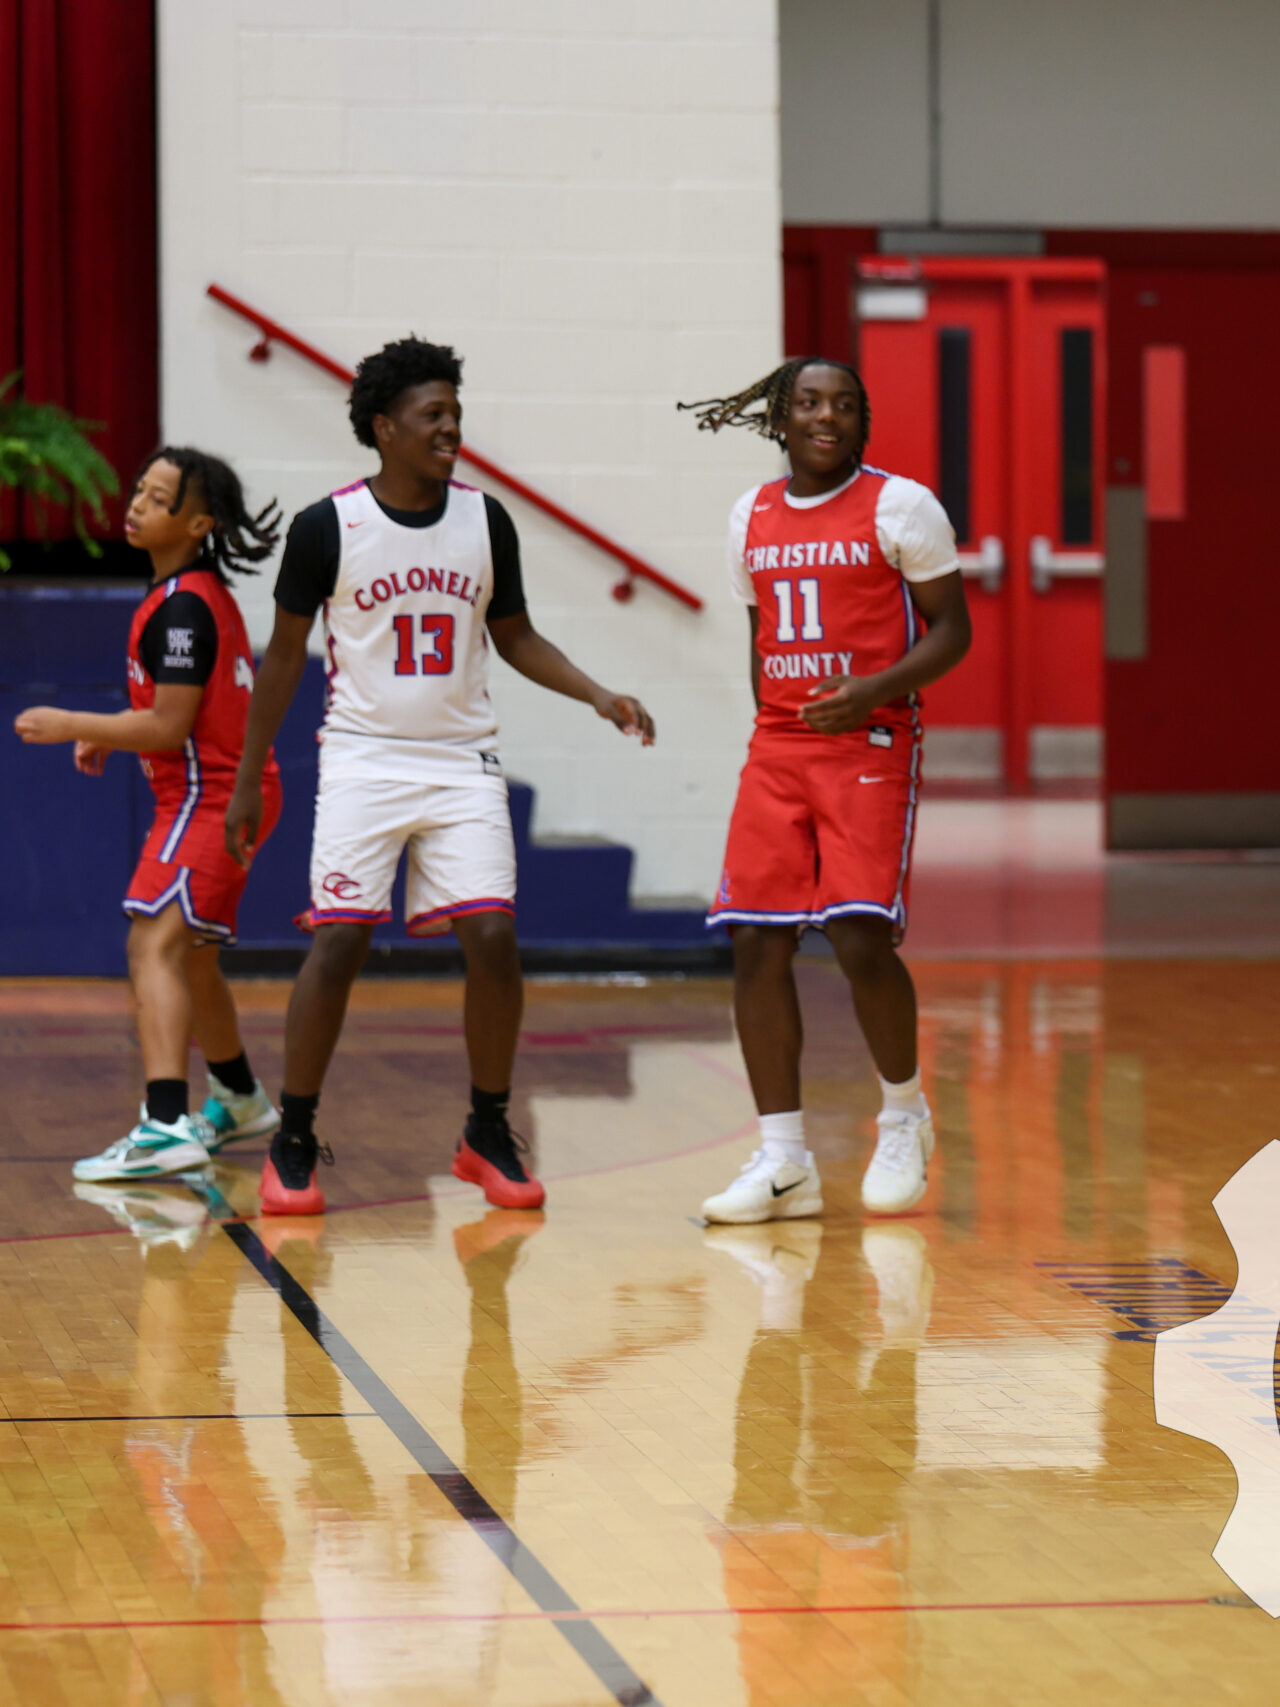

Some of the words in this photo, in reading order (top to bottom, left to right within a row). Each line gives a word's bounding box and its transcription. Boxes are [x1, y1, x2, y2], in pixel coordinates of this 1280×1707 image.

[746, 540, 870, 573] CHRISTIAN
[773, 577, 824, 643] 11
[393, 614, 455, 676] 13
[763, 651, 853, 680] COUNTY
